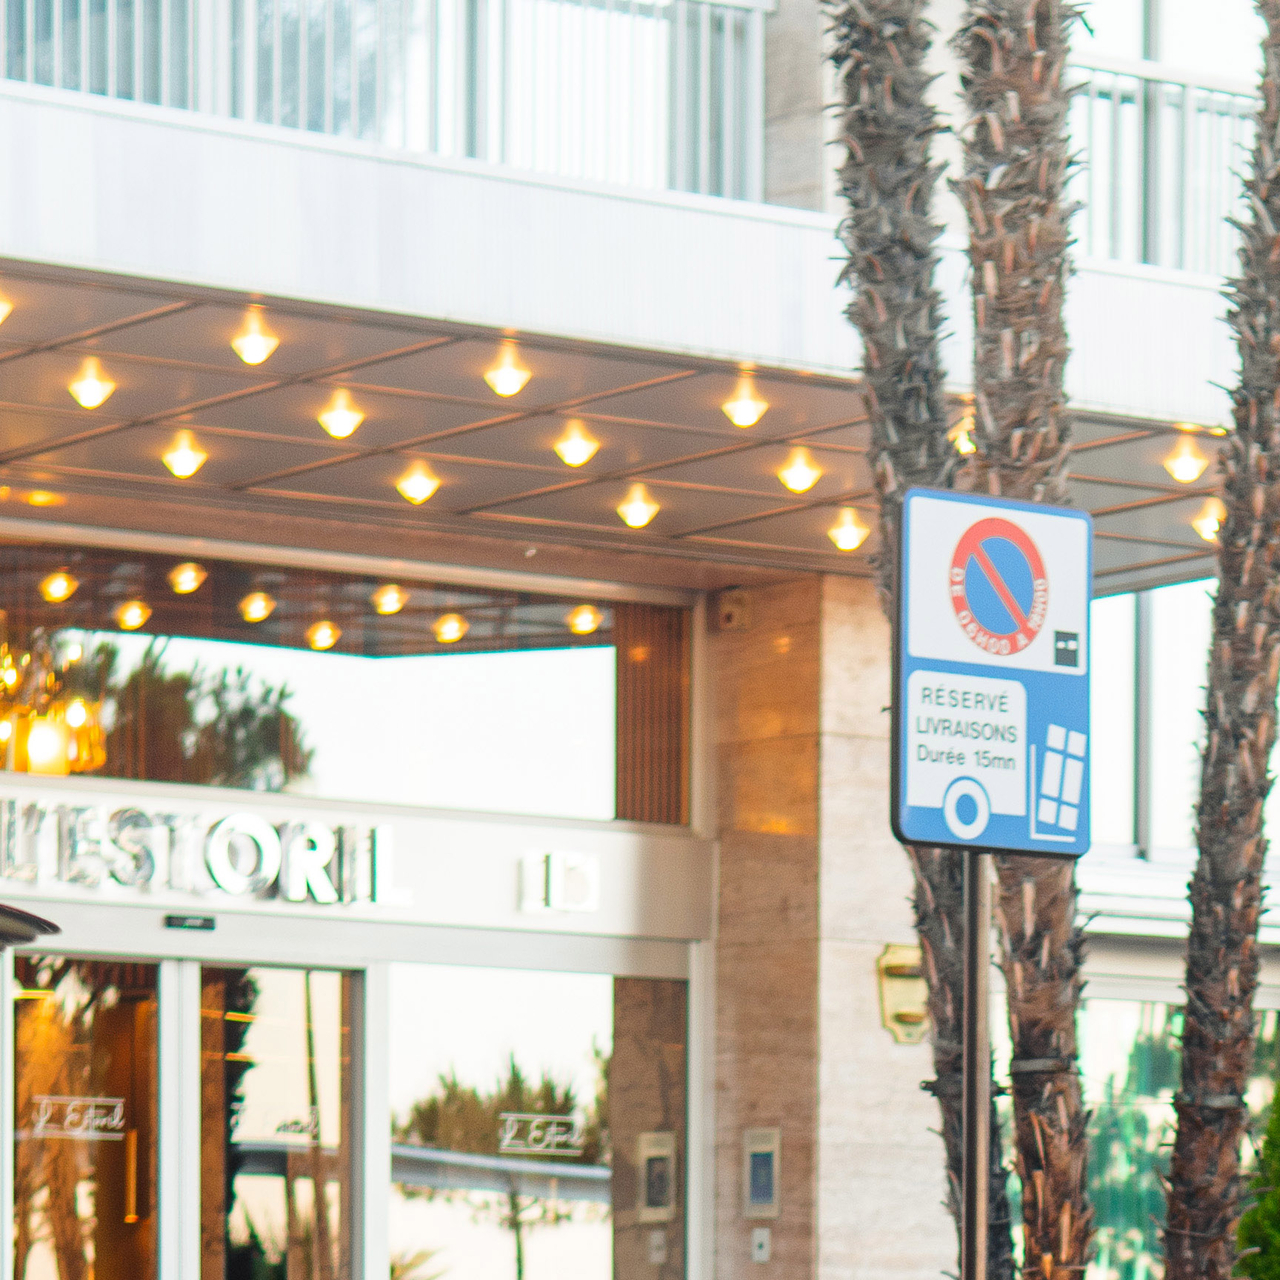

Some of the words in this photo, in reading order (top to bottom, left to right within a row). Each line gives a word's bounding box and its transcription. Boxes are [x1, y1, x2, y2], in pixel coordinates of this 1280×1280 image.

[921, 683, 1009, 713] RÉSERVÉ
[916, 716, 1018, 743] LIVRAISONS
[917, 744, 966, 766] Durée
[973, 750, 1016, 770] 15mn
